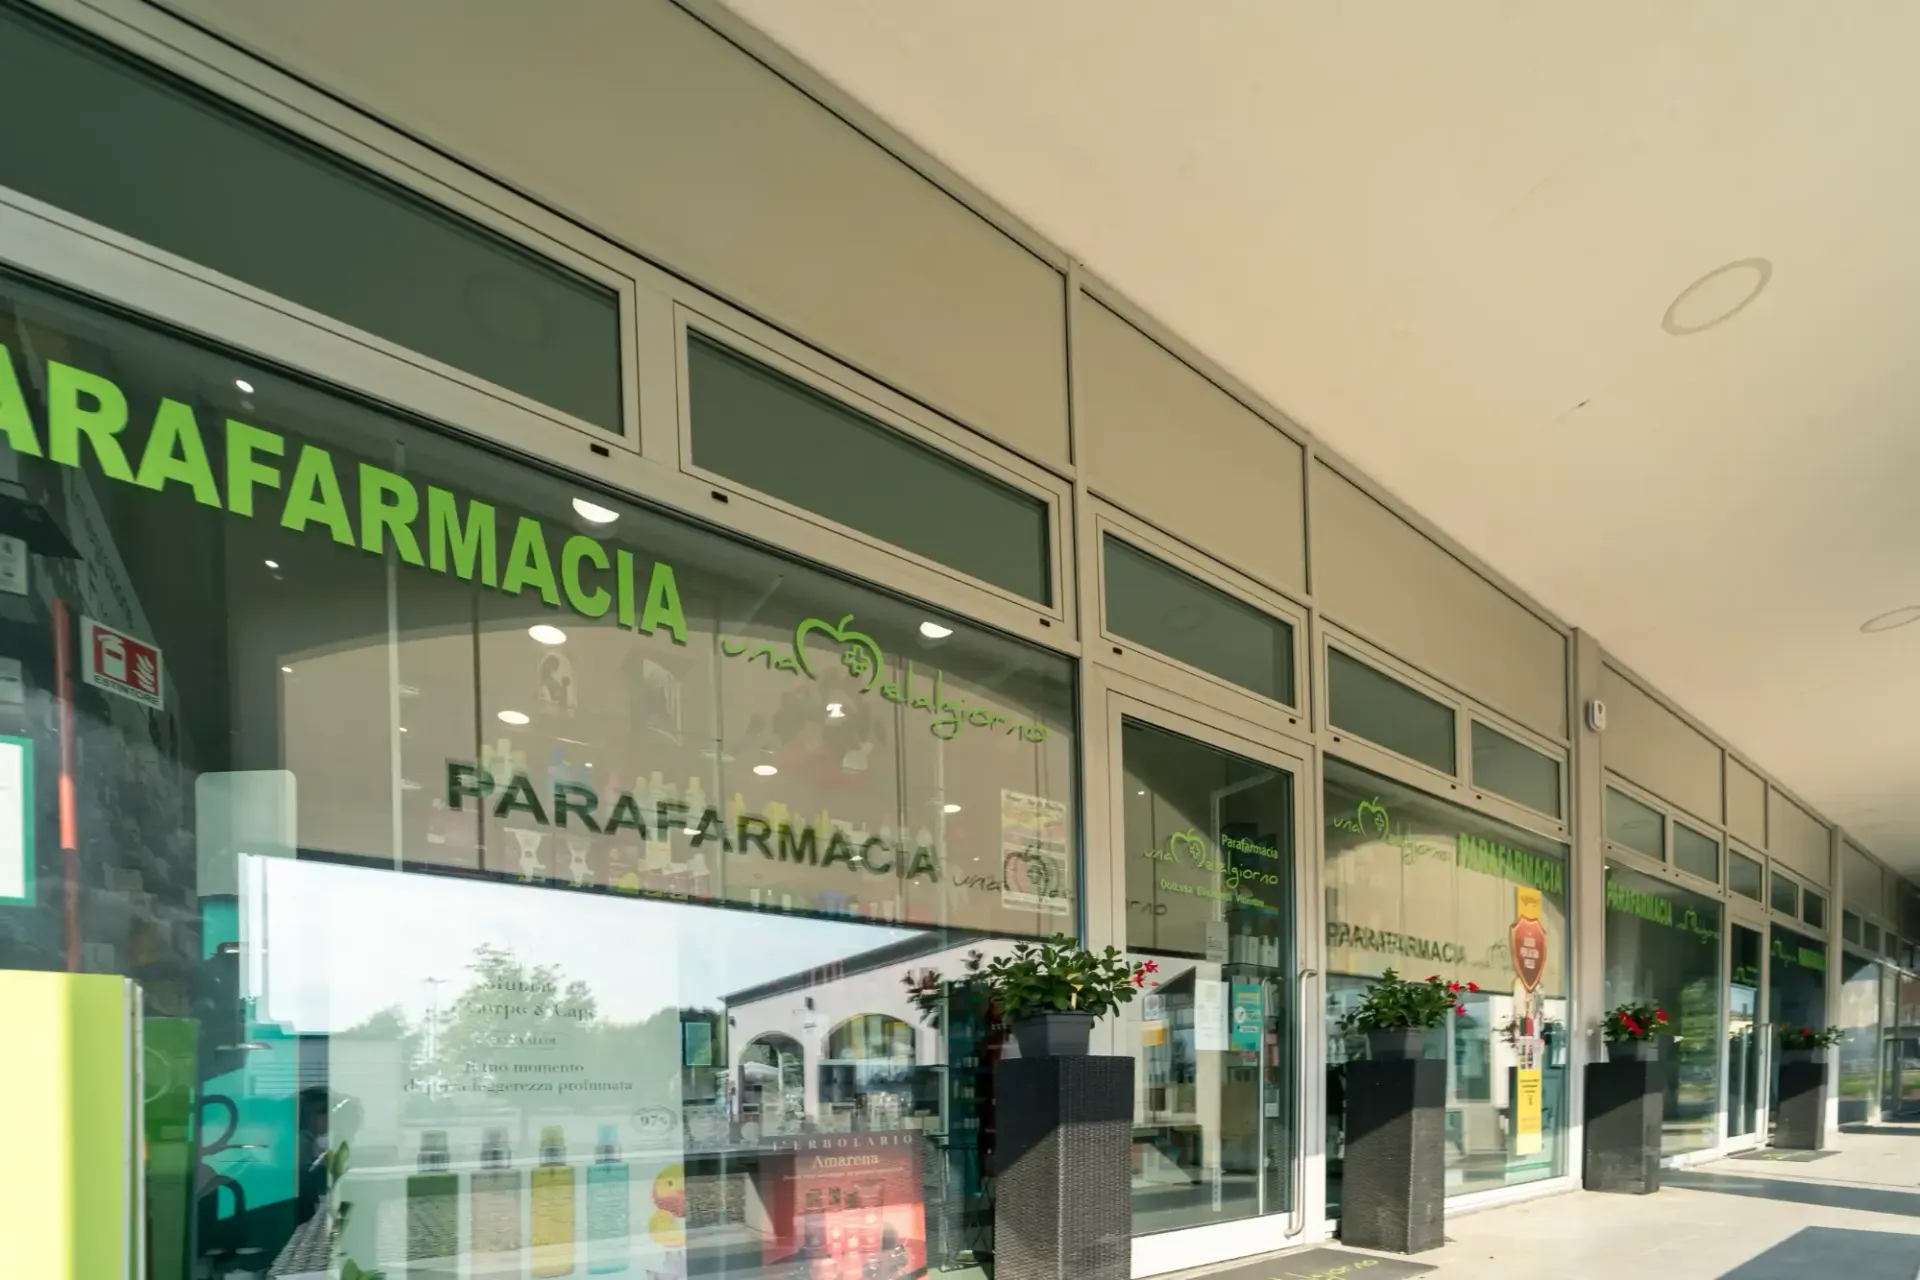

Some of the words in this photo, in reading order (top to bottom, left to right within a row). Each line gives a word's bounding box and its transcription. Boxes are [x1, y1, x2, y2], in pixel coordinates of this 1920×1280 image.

[94, 674, 160, 706] ESTINTORE
[447, 762, 939, 883] PARAFARMACIA
[1221, 833, 1279, 860] Parafarmacia
[1456, 831, 1564, 896] PARAFARMACIA
[513, 1062, 584, 1074] momento
[558, 1078, 633, 1096] profumata
[812, 1154, 880, 1169] Amarena
